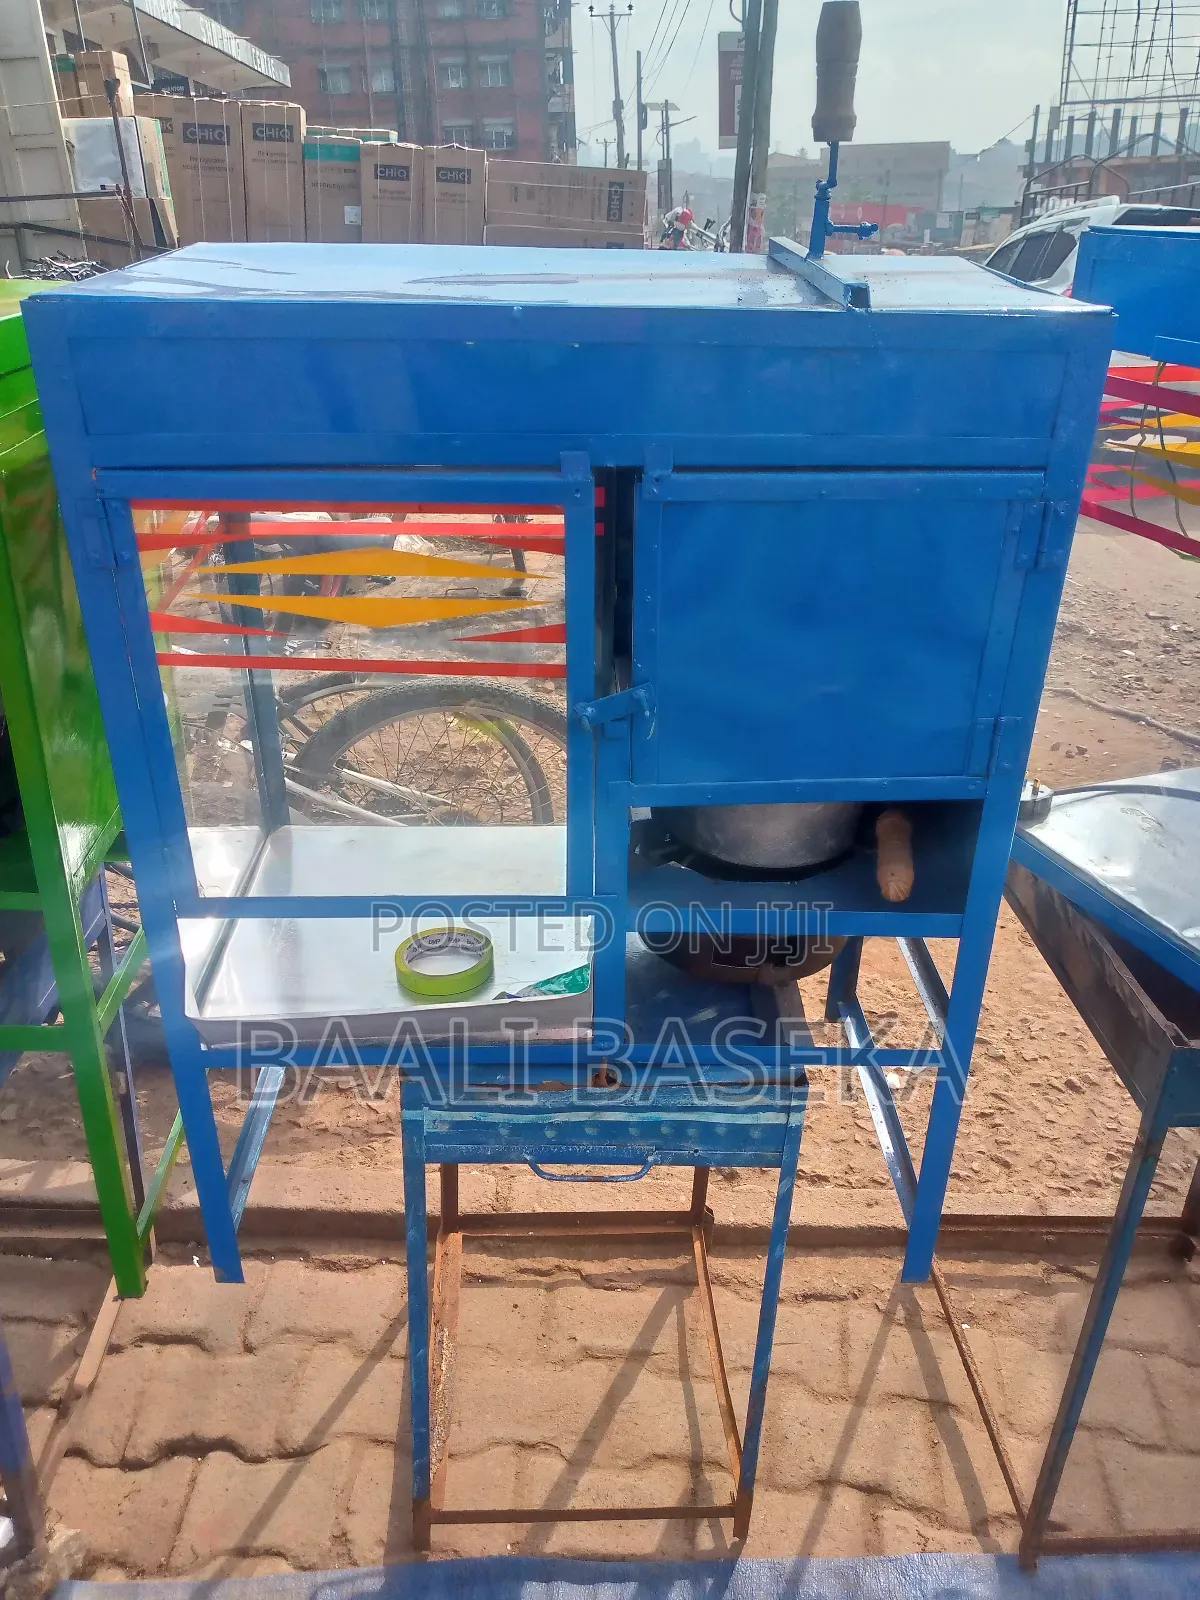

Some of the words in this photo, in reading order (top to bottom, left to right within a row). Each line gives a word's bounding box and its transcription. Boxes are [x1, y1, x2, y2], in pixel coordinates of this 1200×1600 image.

[186, 126, 228, 141] CHiQ
[255, 127, 291, 140] CHiQ
[376, 166, 408, 179] CHiQ
[438, 170, 469, 182] CHiQ
